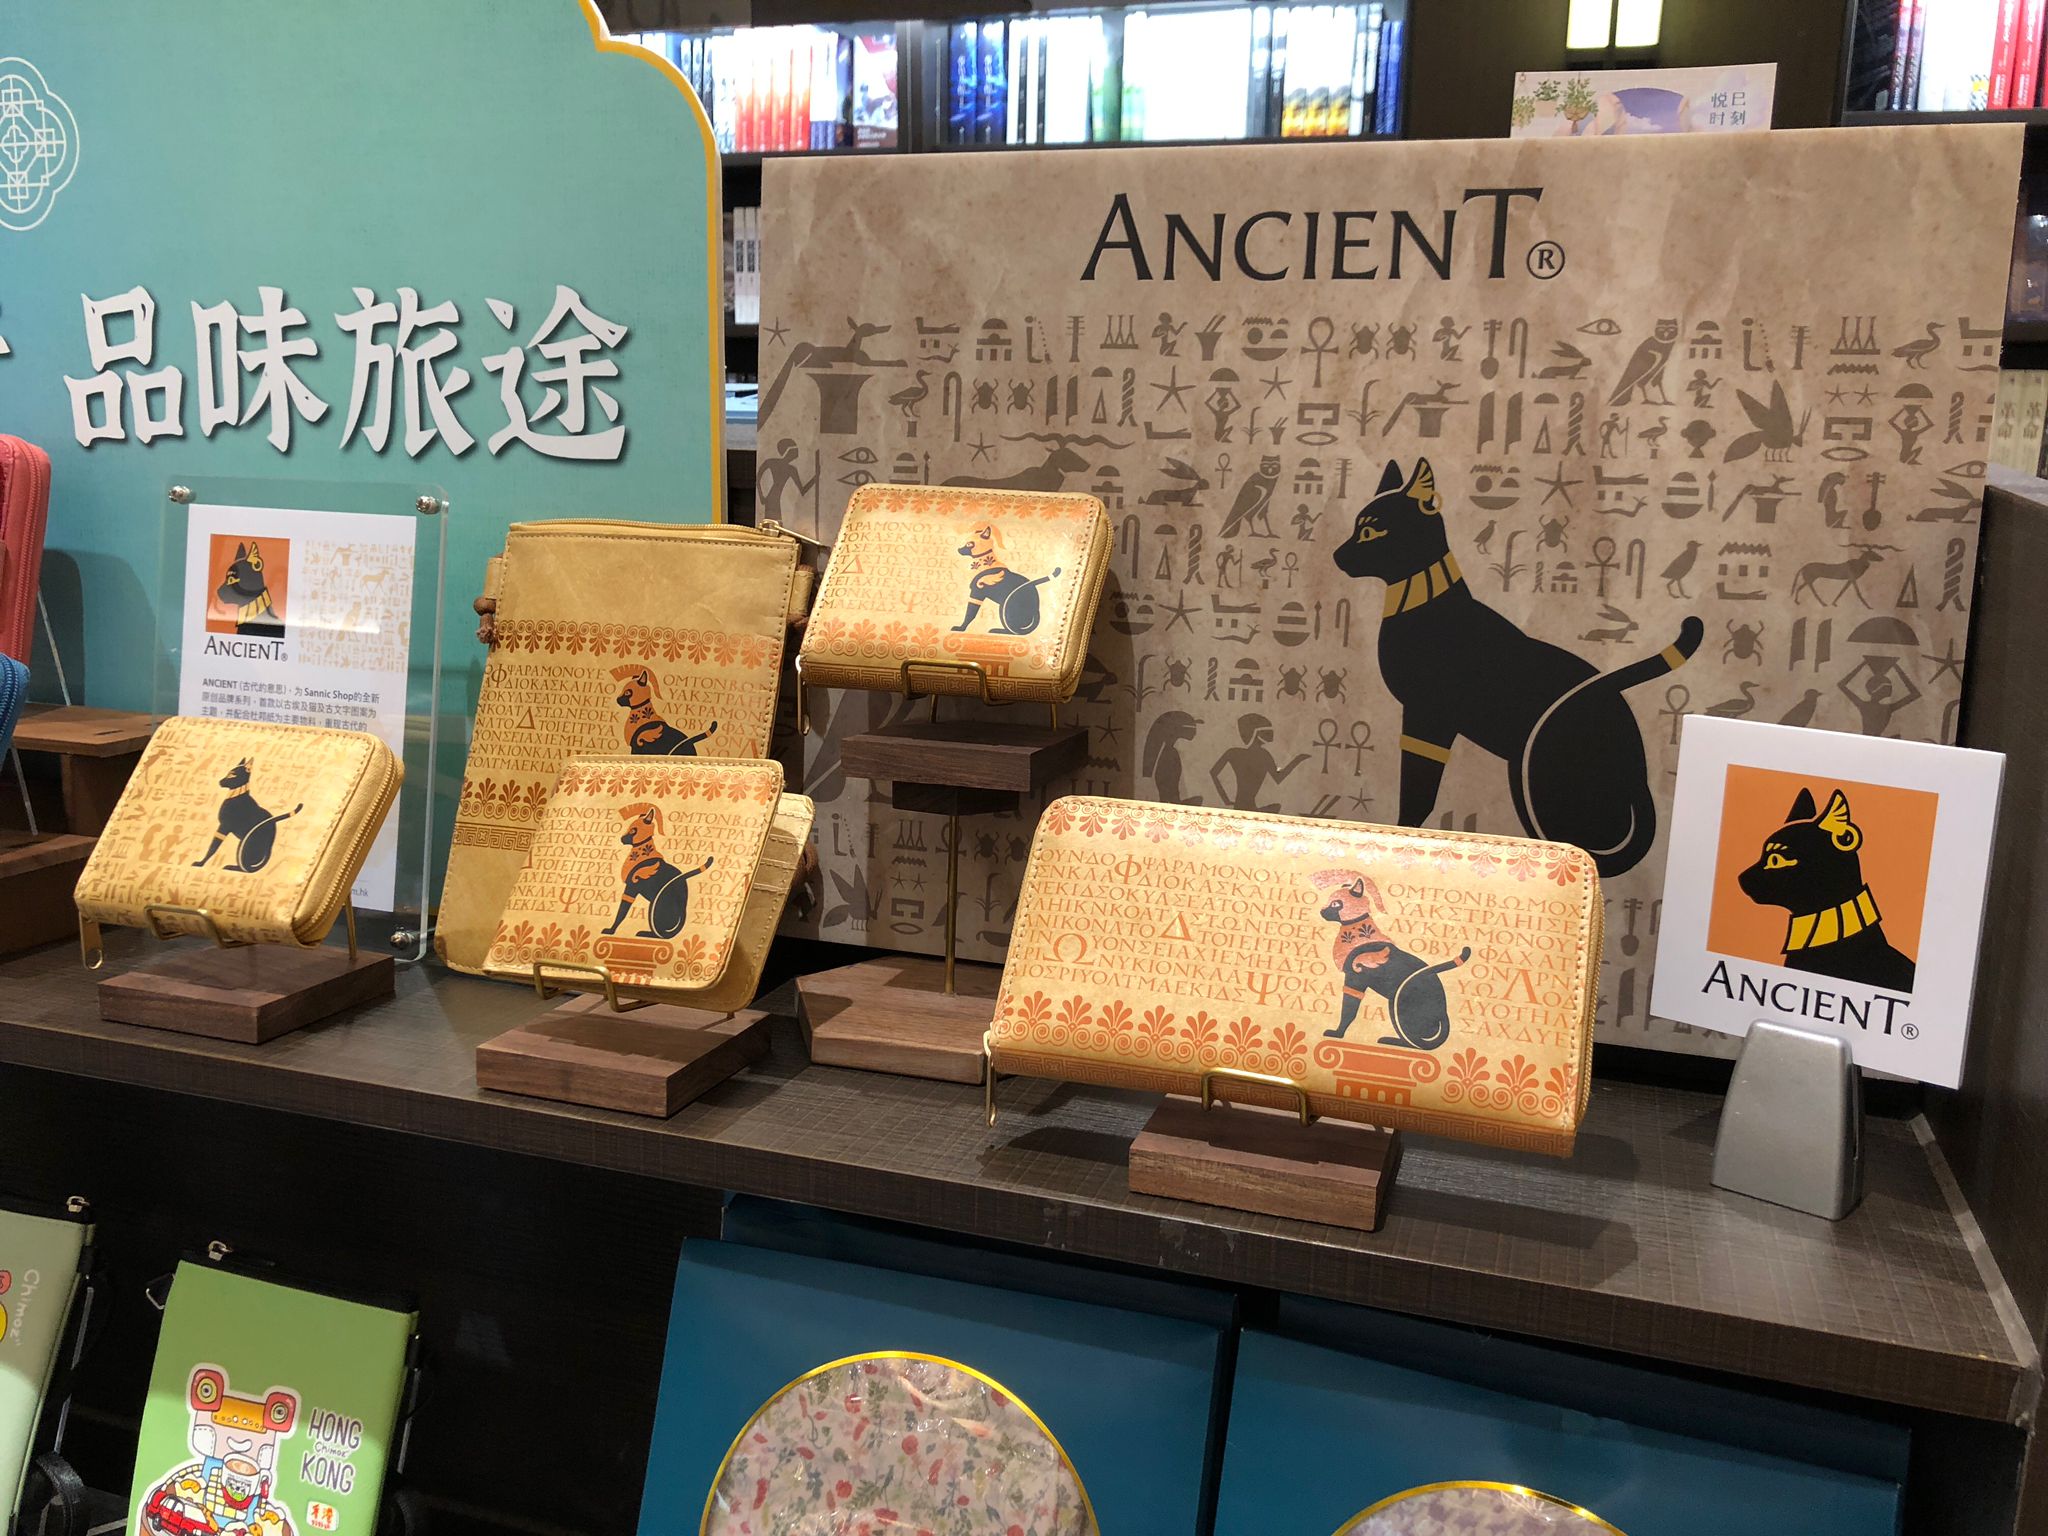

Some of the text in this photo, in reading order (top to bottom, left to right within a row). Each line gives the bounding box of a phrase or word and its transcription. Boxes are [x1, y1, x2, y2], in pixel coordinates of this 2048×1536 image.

[63, 284, 629, 460] 品味旅途
[202, 678, 238, 689] ANCIENT
[304, 687, 331, 699] Sannic
[308, 1408, 362, 1449] HONG
[301, 1452, 354, 1493] KONG
